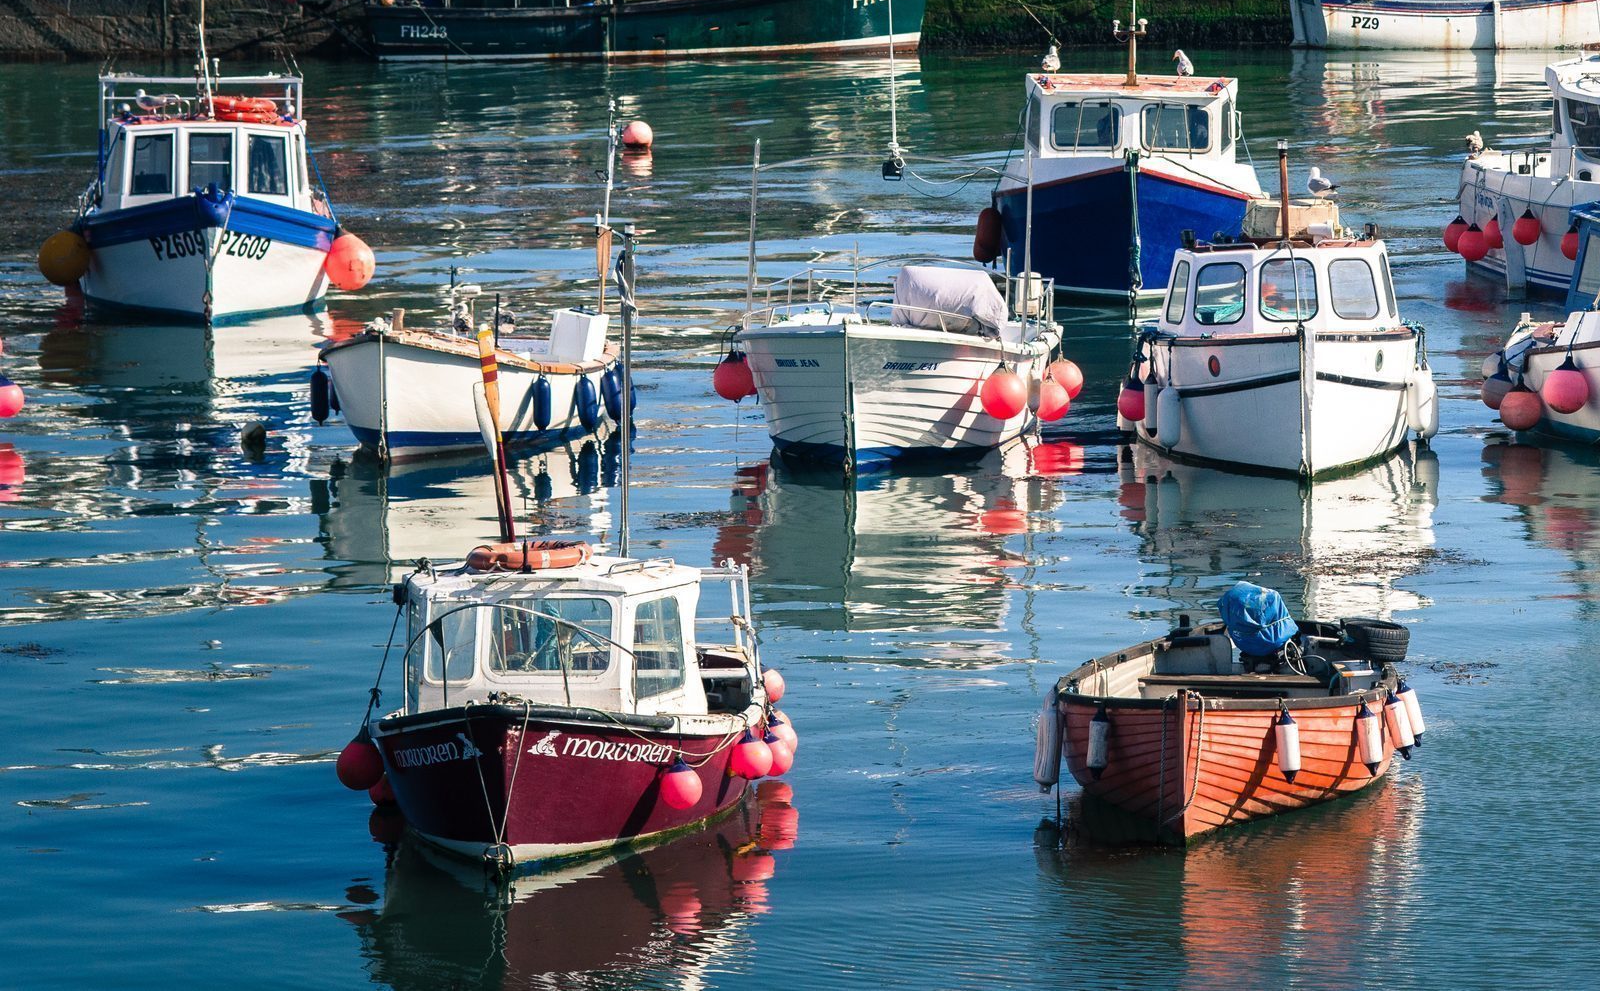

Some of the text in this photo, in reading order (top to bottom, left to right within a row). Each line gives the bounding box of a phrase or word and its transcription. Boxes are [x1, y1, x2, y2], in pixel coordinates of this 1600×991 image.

[1351, 16, 1379, 30] PZ9
[400, 25, 448, 39] FH243
[149, 230, 207, 261] PZ609
[217, 229, 272, 260] PZ609
[775, 359, 820, 368] BRIDIE JEAN
[882, 361, 914, 371] BRIDIE
